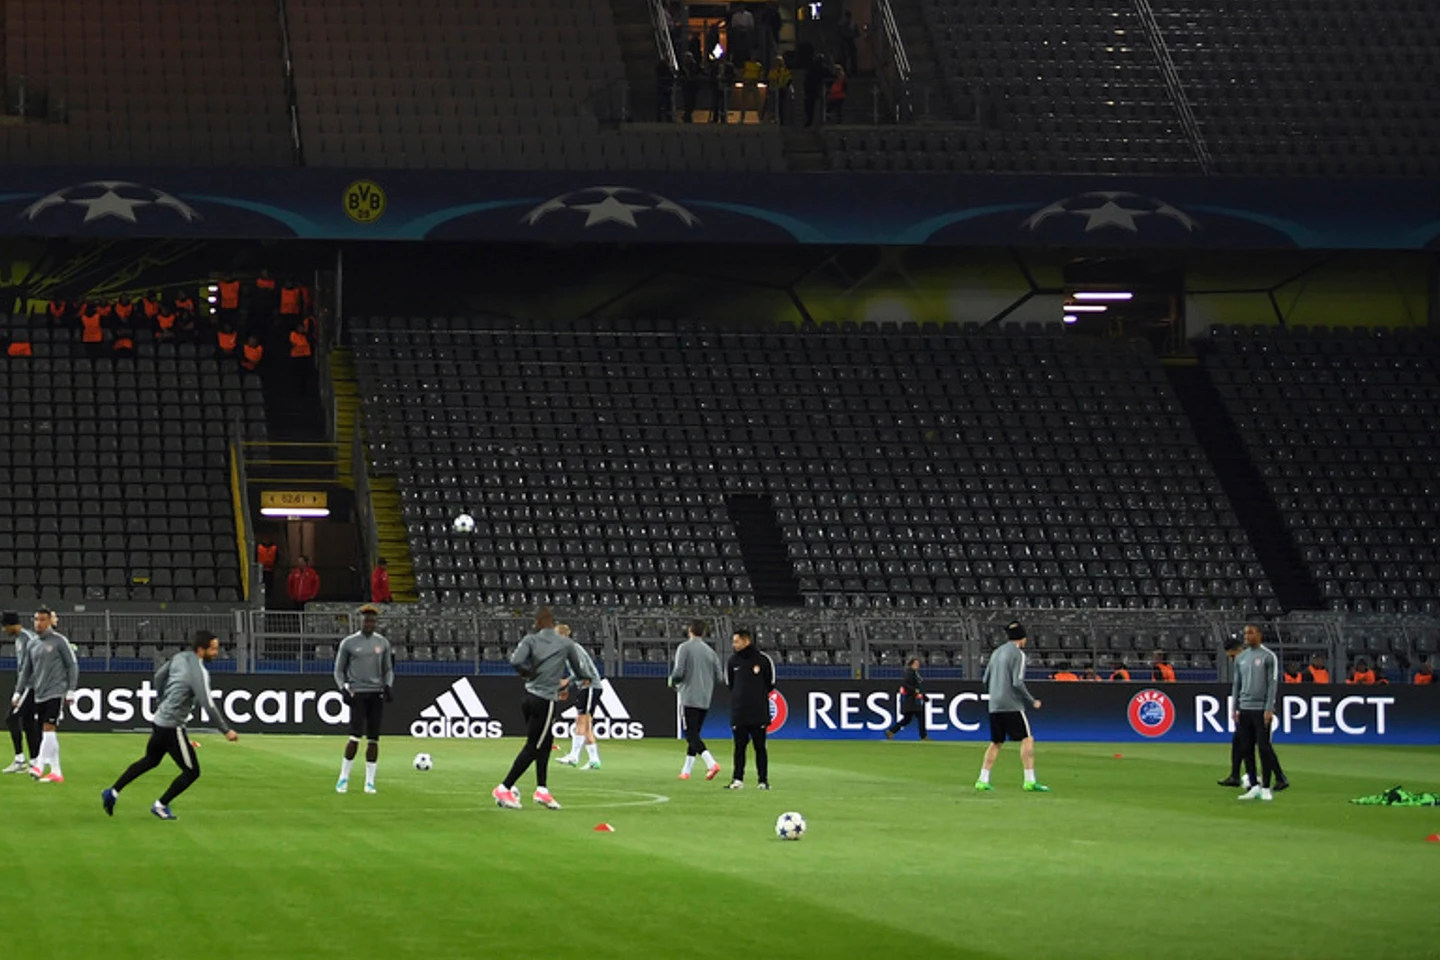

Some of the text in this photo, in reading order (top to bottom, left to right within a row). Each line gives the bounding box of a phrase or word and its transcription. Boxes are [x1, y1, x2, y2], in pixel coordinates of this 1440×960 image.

[348, 183, 380, 210] BVB
[1136, 691, 1165, 705] UEFA
[1194, 695, 1396, 735] RPECT
[410, 718, 503, 739] adidas
[551, 717, 645, 740] adas
